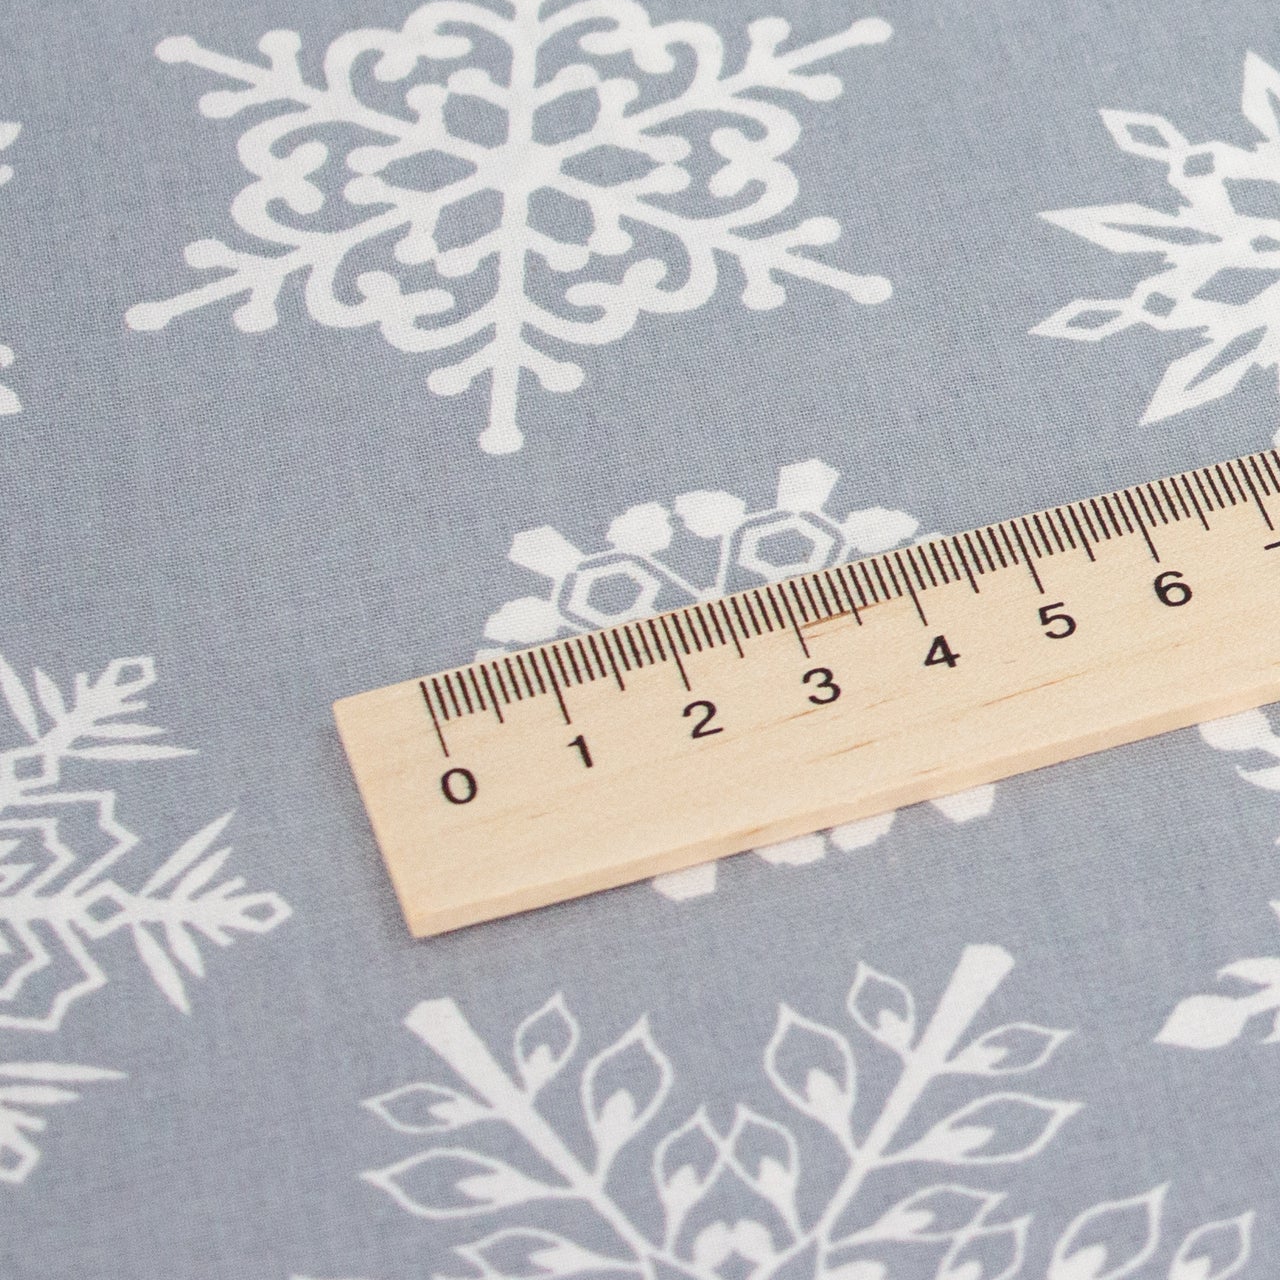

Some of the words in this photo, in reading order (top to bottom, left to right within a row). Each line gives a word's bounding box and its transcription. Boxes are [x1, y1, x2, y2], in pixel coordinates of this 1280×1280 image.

[440, 767, 479, 806] 0
[567, 734, 594, 769] 1
[682, 700, 724, 740] 2
[801, 667, 842, 706] 3
[923, 634, 961, 669] 4
[1038, 601, 1077, 640] 5
[1153, 570, 1193, 608] 6
